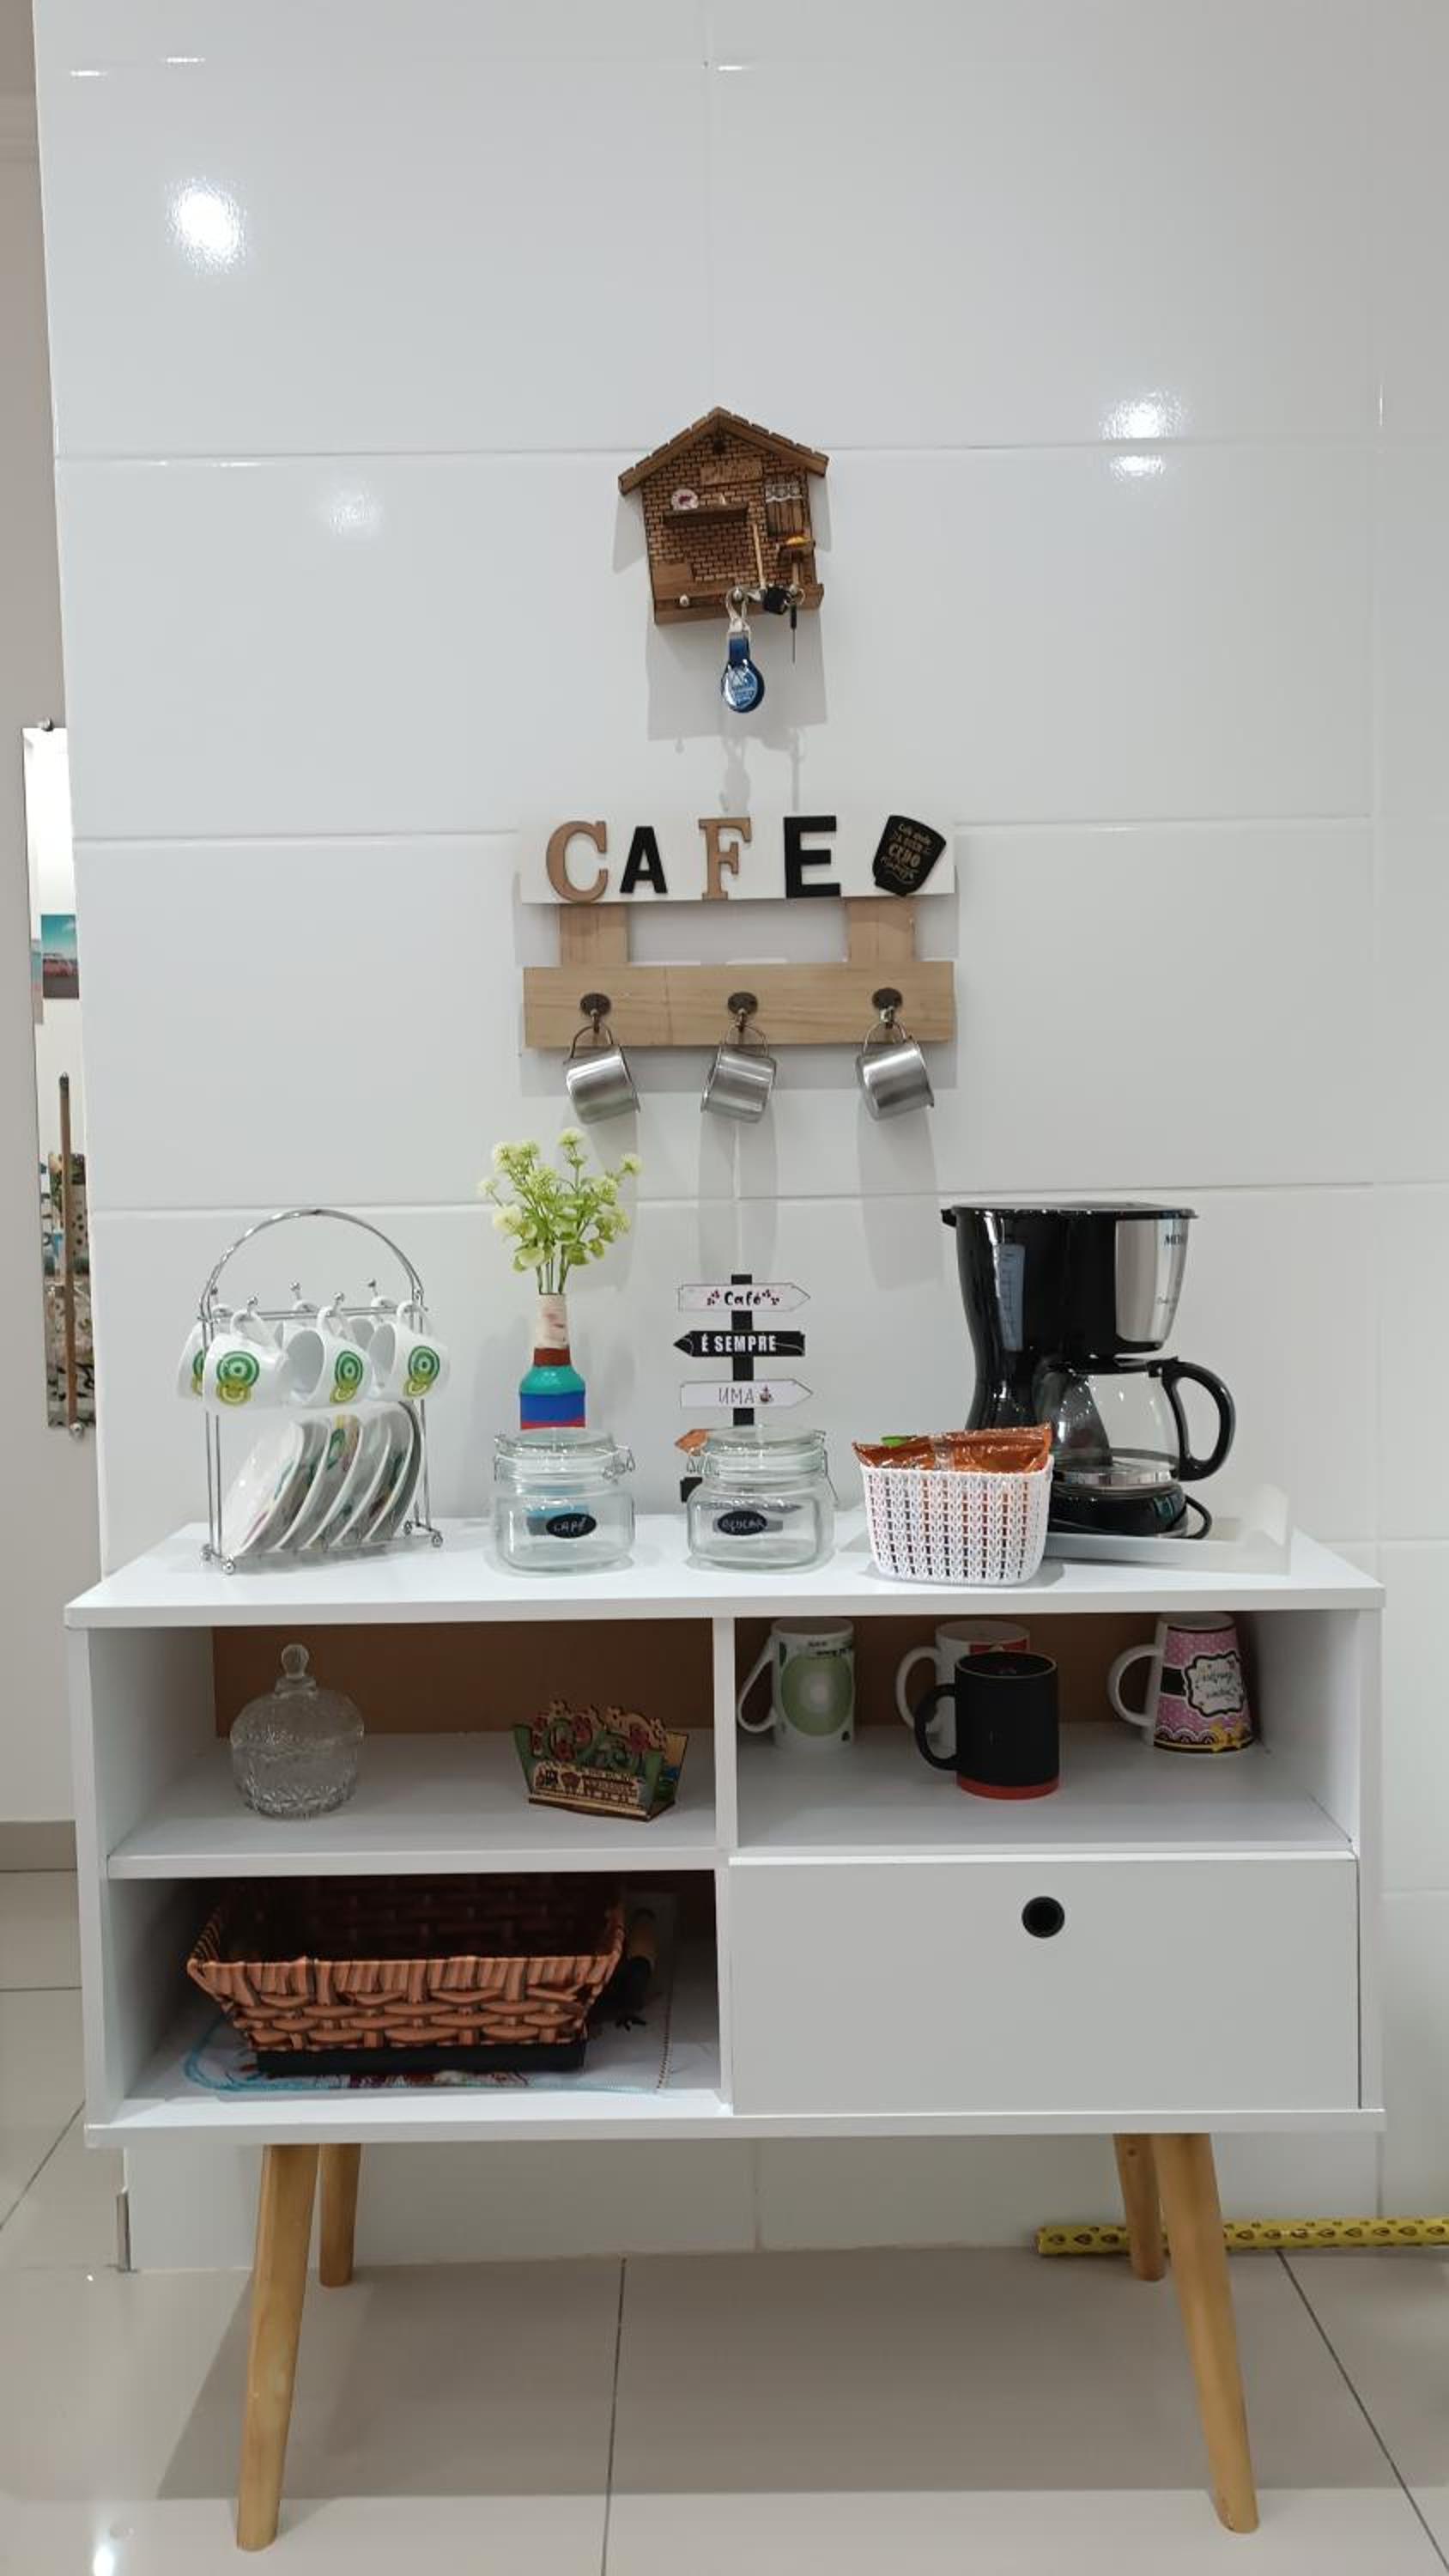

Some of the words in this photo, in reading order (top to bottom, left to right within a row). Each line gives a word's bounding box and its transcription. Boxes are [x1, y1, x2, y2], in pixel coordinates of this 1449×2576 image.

[546, 816, 841, 902] CAFE
[724, 1291, 761, 1306] Café
[701, 1334, 709, 1352] É
[714, 1335, 777, 1352] SEMPRE
[718, 1388, 755, 1405] UMA
